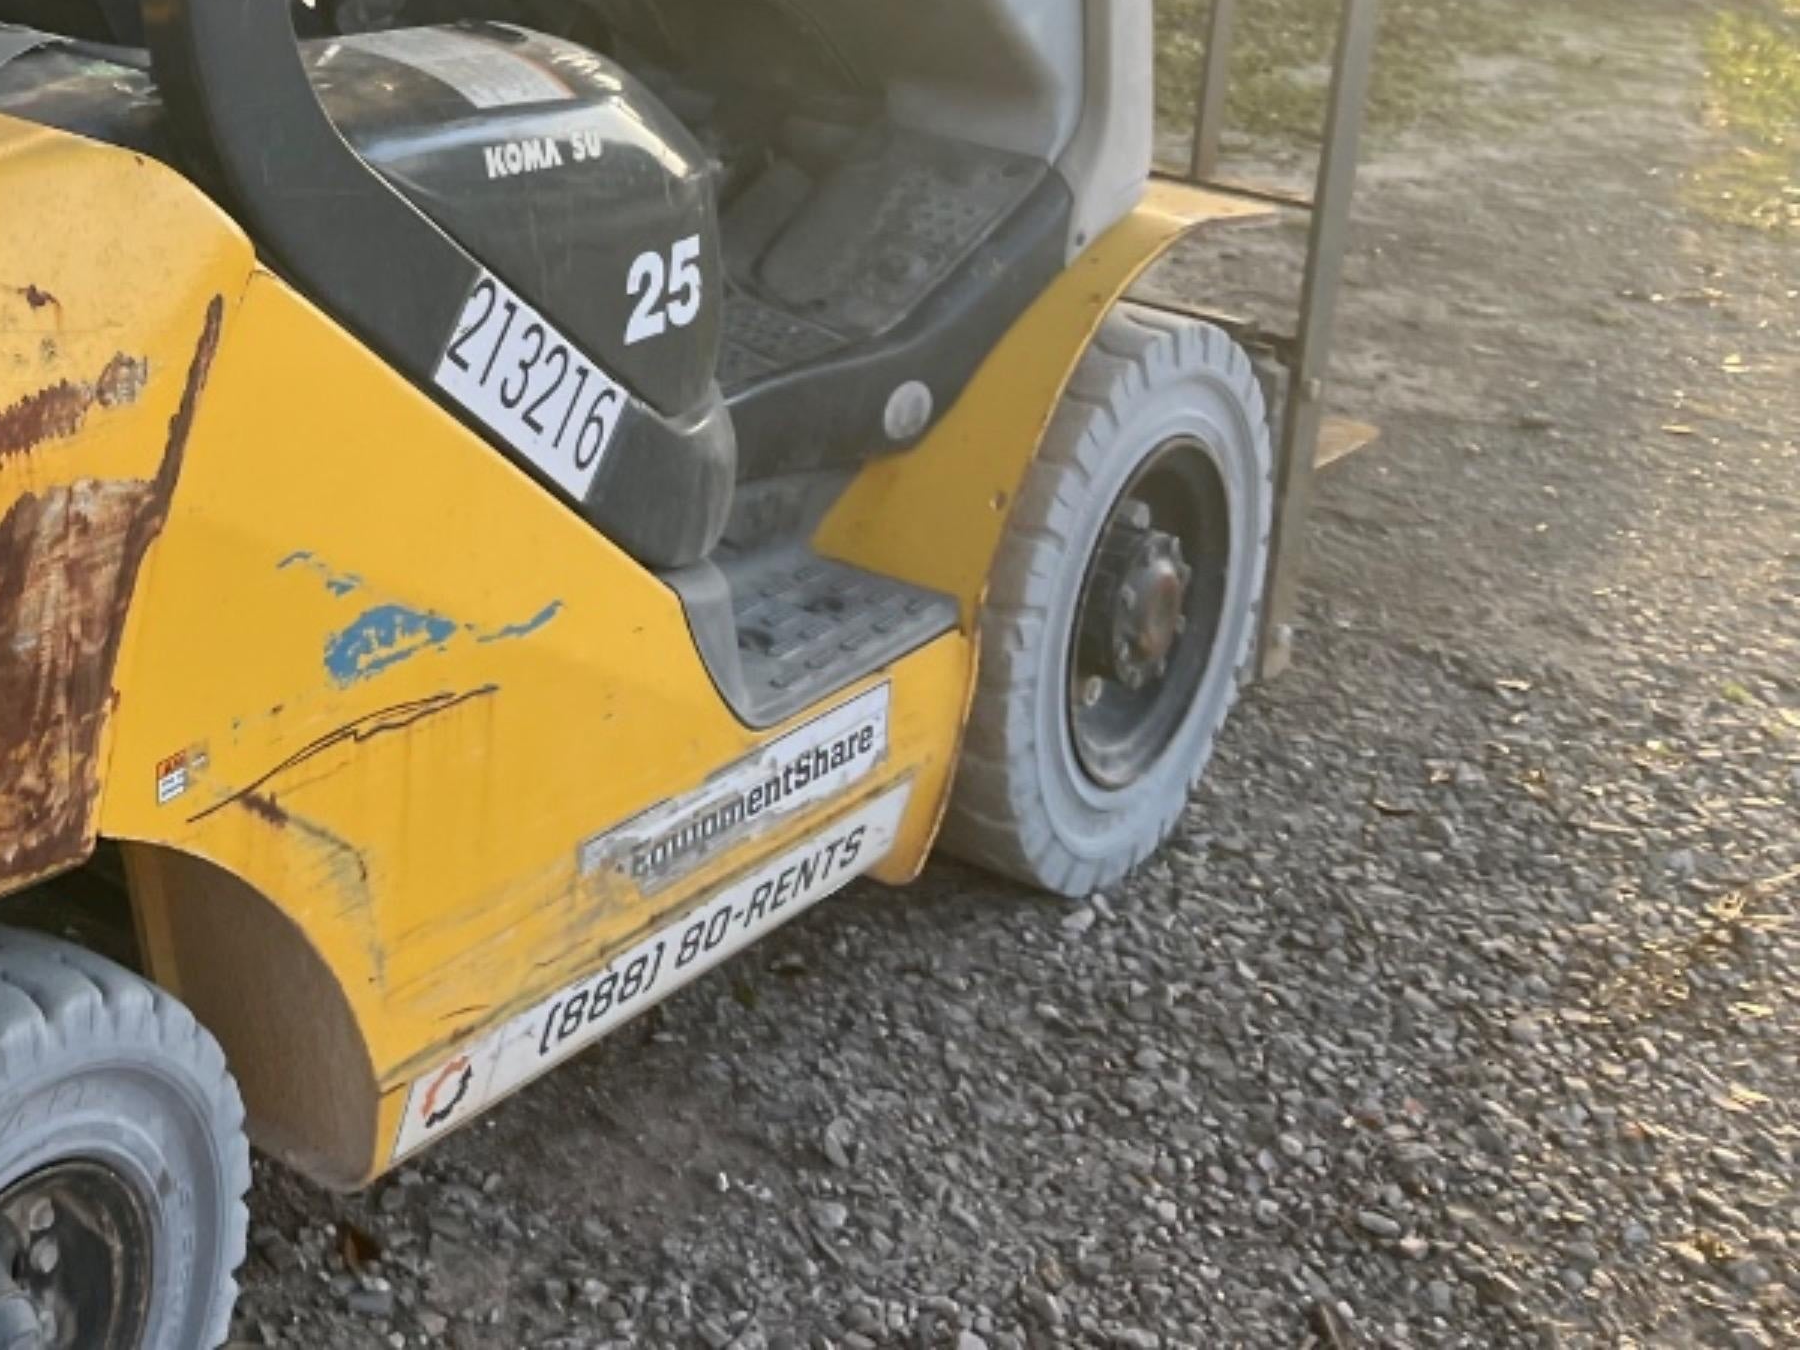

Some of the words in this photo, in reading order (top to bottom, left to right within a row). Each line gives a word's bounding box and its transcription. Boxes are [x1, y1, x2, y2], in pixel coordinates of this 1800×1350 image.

[447, 279, 616, 471] 213216
[624, 234, 701, 346] 25
[539, 941, 666, 1056] (888)
[675, 825, 865, 969] 80-RENTS
